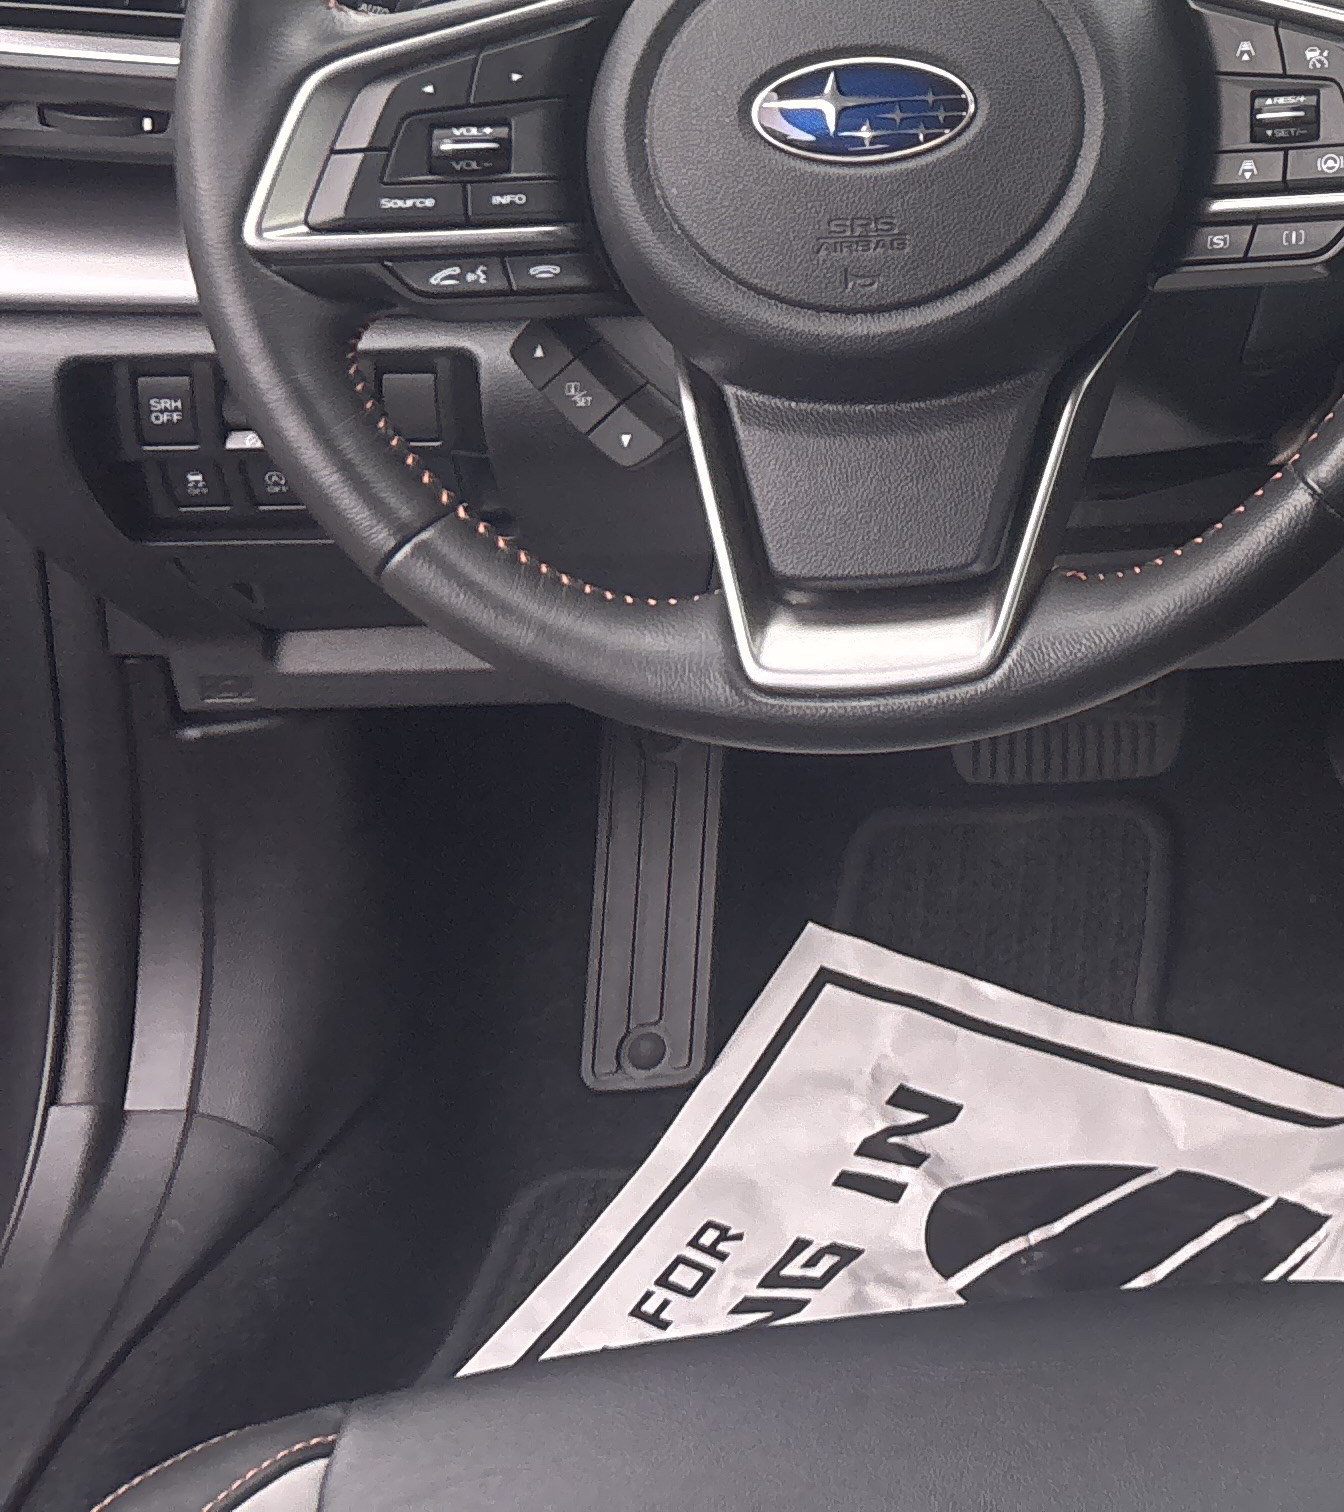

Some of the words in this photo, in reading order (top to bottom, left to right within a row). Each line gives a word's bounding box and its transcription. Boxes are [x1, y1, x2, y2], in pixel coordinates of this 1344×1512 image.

[491, 193, 527, 205] INFO
[827, 216, 896, 234] SRS
[149, 398, 182, 411] SRH
[150, 411, 183, 424] OFF
[831, 1083, 964, 1205] IN
[628, 1219, 745, 1332] FOR
